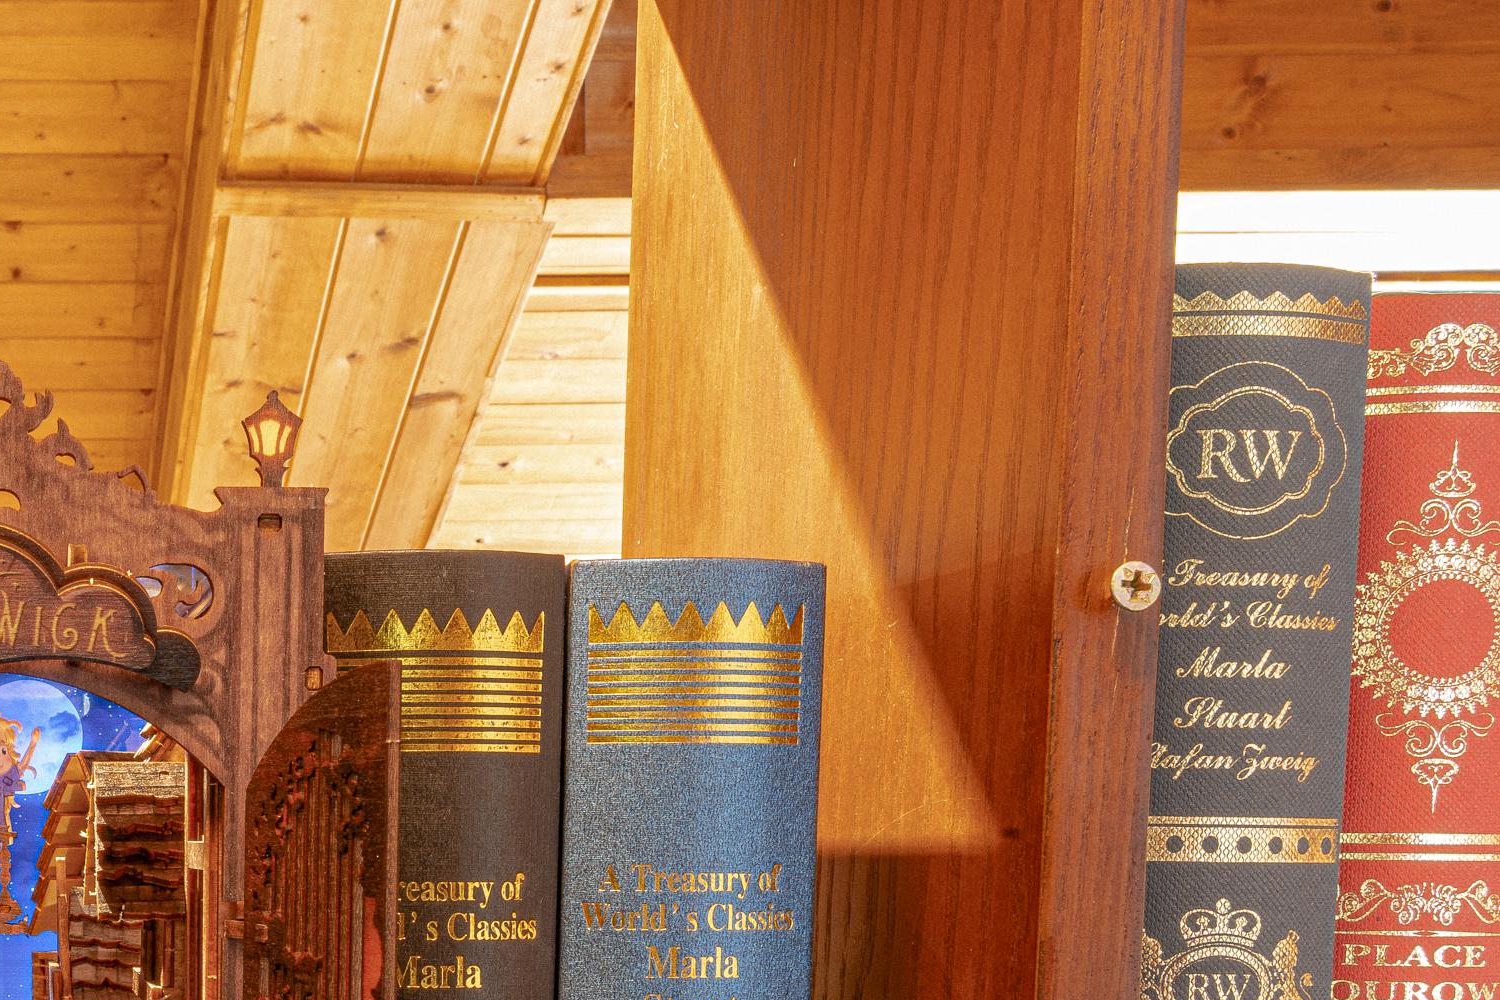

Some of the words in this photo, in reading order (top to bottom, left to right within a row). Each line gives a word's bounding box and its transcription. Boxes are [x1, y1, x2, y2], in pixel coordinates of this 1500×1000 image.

[1196, 429, 1302, 483] RW
[1168, 558, 1300, 600] Treasury
[1304, 563, 1332, 600] of
[1159, 601, 1240, 629] rld's
[1176, 646, 1291, 680] Marla
[1173, 696, 1293, 730] Stuart
[1236, 743, 1320, 783] Zweig
[501, 873, 525, 902] of
[598, 864, 621, 892] A
[631, 864, 752, 899] Treasury
[758, 864, 783, 892] of
[396, 955, 482, 989] Marla
[644, 945, 740, 980] Marla
[1341, 943, 1486, 968] PLACE
